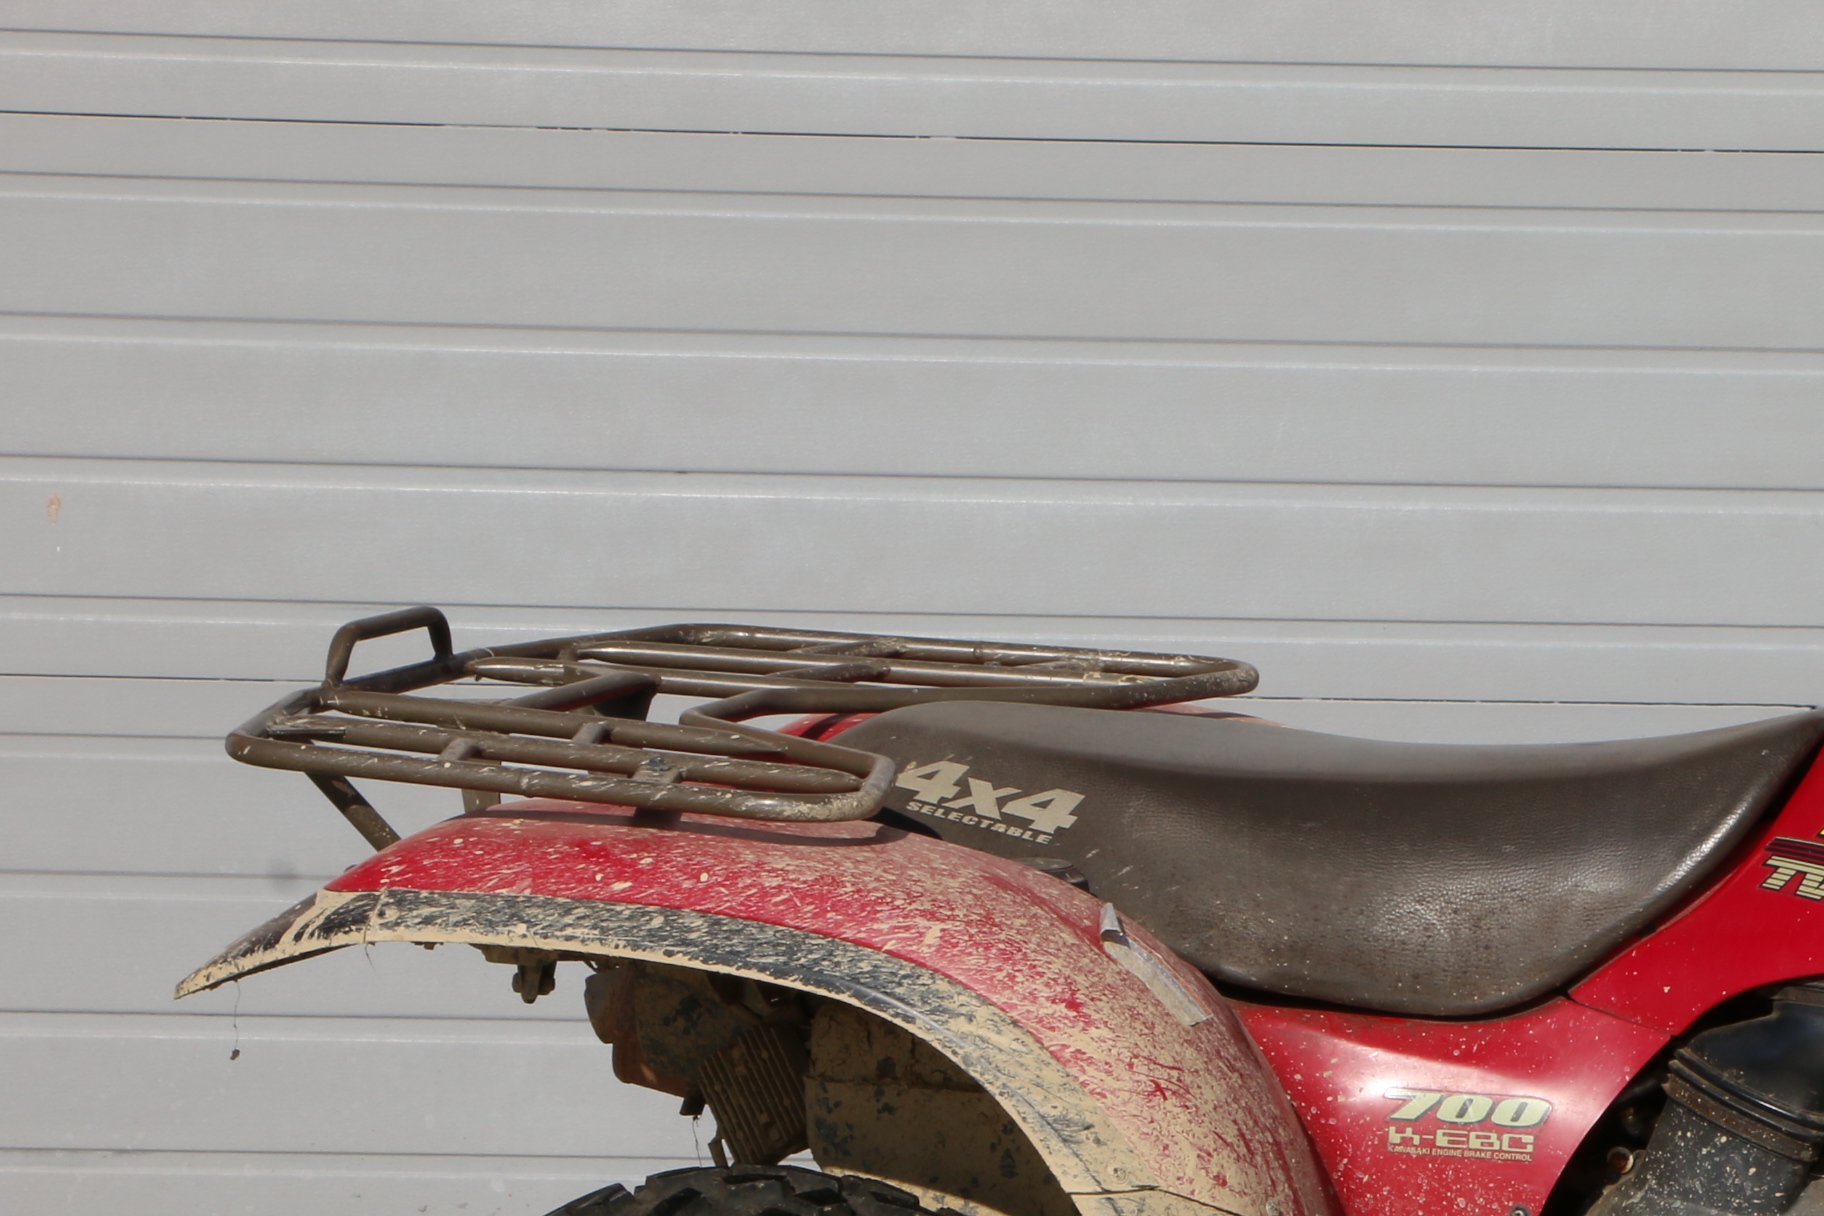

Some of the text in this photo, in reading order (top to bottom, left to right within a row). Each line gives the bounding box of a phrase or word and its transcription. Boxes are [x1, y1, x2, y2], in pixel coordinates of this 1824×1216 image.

[906, 801, 1052, 845] SELECTABLE
[1384, 1087, 1552, 1127] 700
[1388, 1126, 1534, 1152] K-EBC
[1388, 1143, 1532, 1161] KAWASAKI ENGINE BRAKE CONTROL
